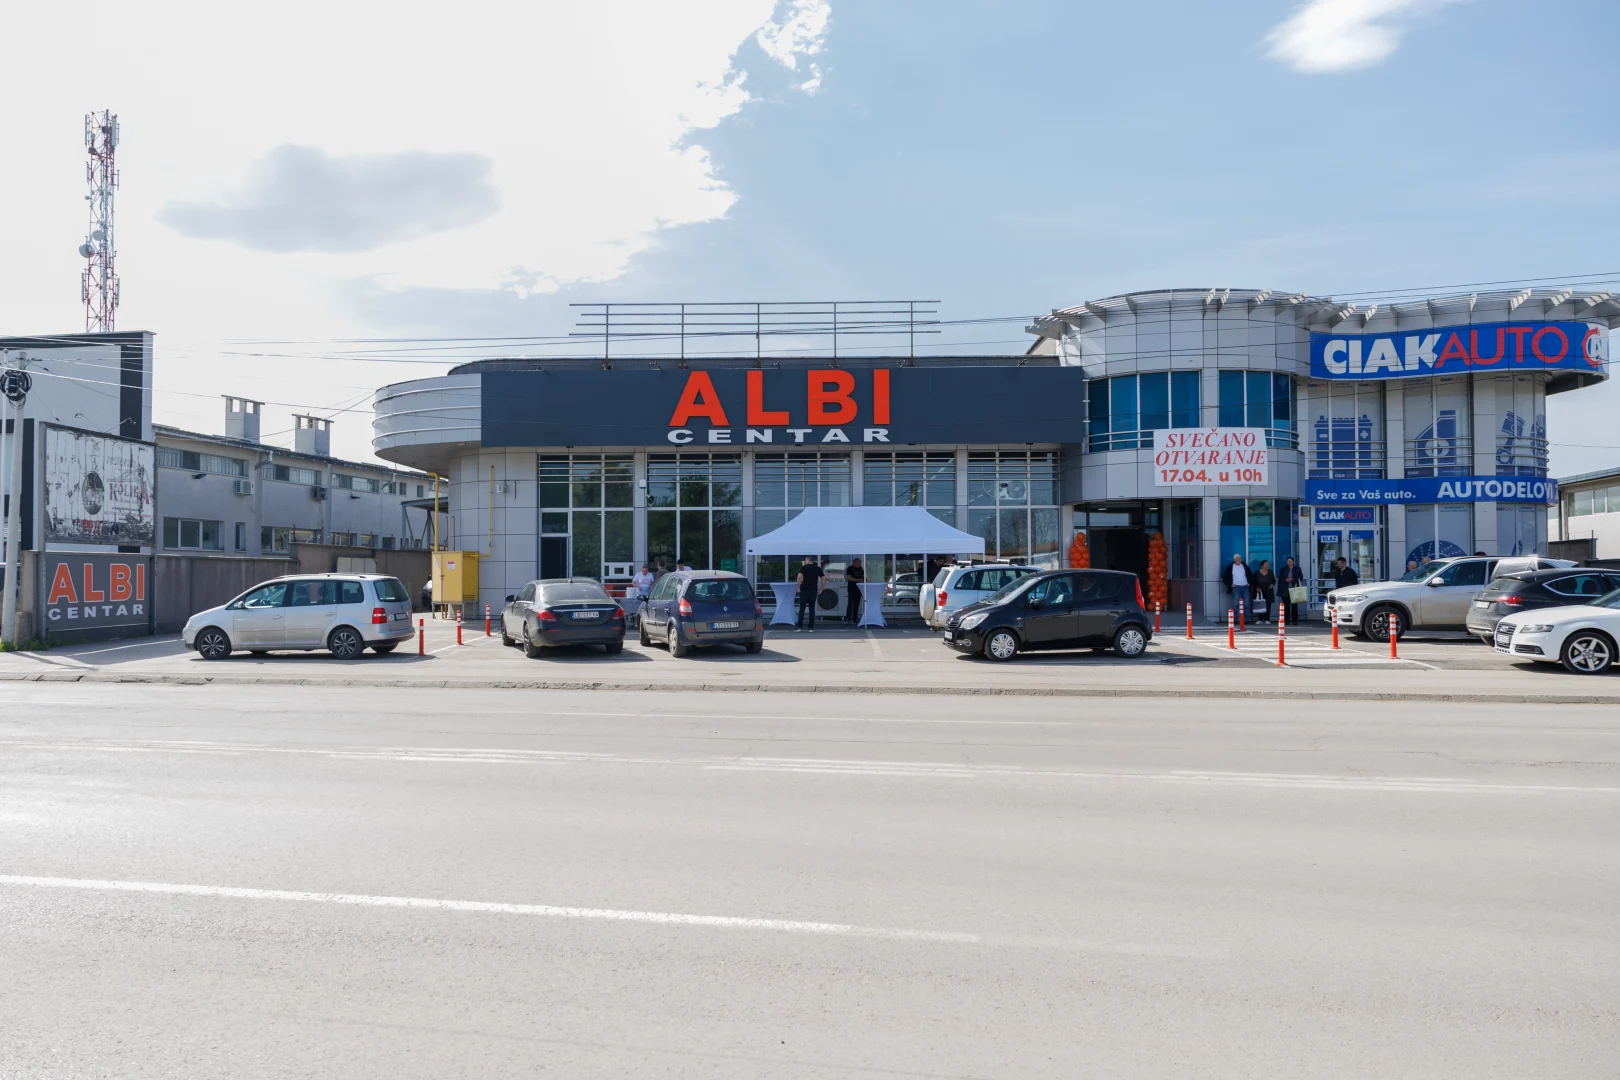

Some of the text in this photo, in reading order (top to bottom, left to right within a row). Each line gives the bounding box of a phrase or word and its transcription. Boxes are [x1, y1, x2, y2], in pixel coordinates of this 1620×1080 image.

[1323, 326, 1569, 375] CIAKAUTO
[668, 368, 891, 427] ALBI
[667, 428, 890, 444] CENTAR
[1165, 428, 1256, 448] SVEČANO
[1155, 450, 1266, 467] OTVARANJE
[1161, 469, 1262, 483] 17.04. u 10h
[1317, 489, 1416, 500] Sve za Vaš auto.
[1437, 480, 1553, 499] AUTODELOVI
[1318, 511, 1371, 520] CIAKAUTO
[47, 563, 145, 605] ALBI
[48, 604, 144, 620] CENTAR
